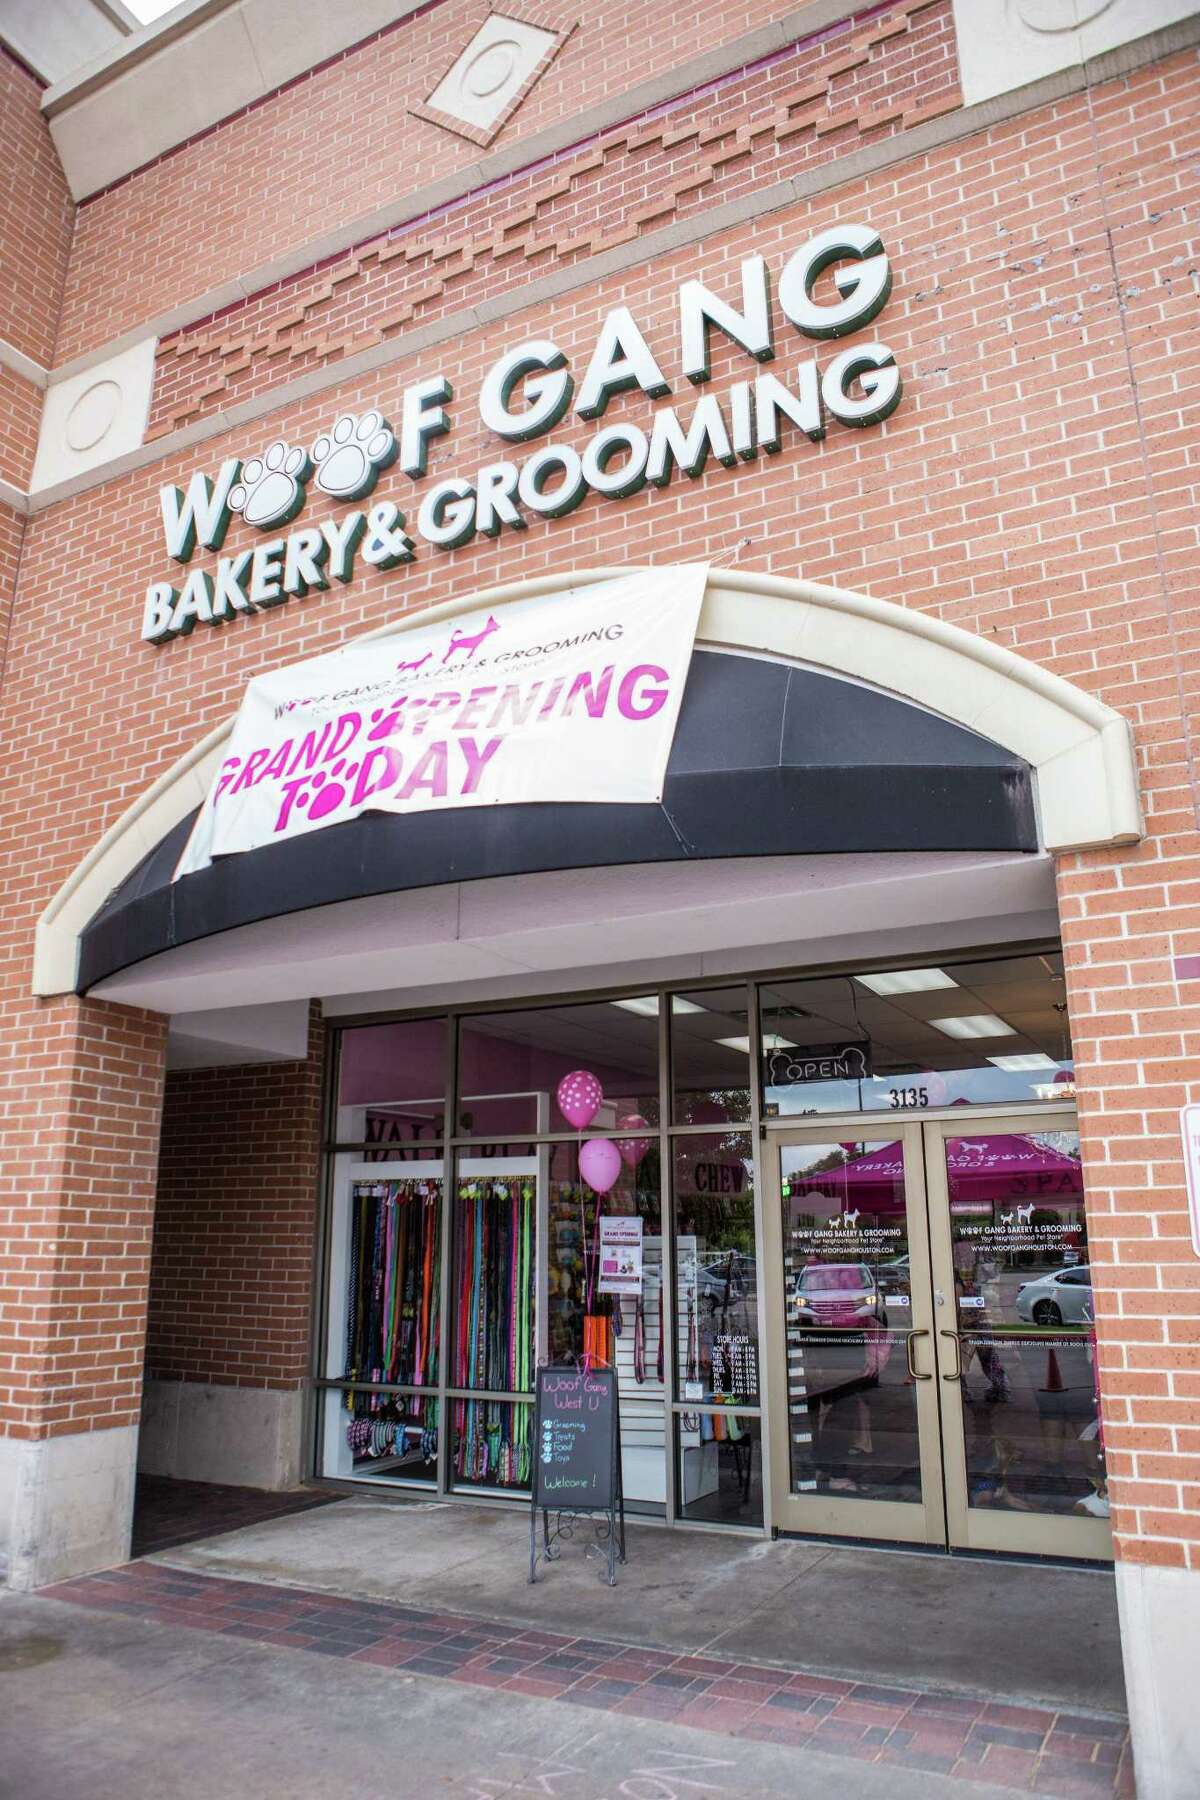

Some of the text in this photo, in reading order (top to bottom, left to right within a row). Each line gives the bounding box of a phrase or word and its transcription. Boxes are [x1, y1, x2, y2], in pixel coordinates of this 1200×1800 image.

[479, 223, 893, 441] GANG
[141, 343, 903, 645] BAKERY & GROOMING
[493, 624, 624, 665] GROOMING
[786, 1060, 849, 1079] OPEN
[889, 1086, 929, 1109] 3135
[694, 1162, 745, 1193] CHEW
[864, 1228, 901, 1237] GROOMING
[985, 1226, 1005, 1234] GANG
[1007, 1225, 1032, 1233] BAKERY
[1041, 1224, 1082, 1233] GROOMING
[971, 1244, 1072, 1252] WWW.WOOFGANGHOUSTON.COM
[717, 1335, 749, 1344] STORE HOURS
[543, 1376, 608, 1396] Woof Gang
[554, 1393, 599, 1410] West U
[553, 1419, 585, 1432] Grooming
[554, 1441, 573, 1451] Food
[545, 1475, 588, 1489] Welcome
